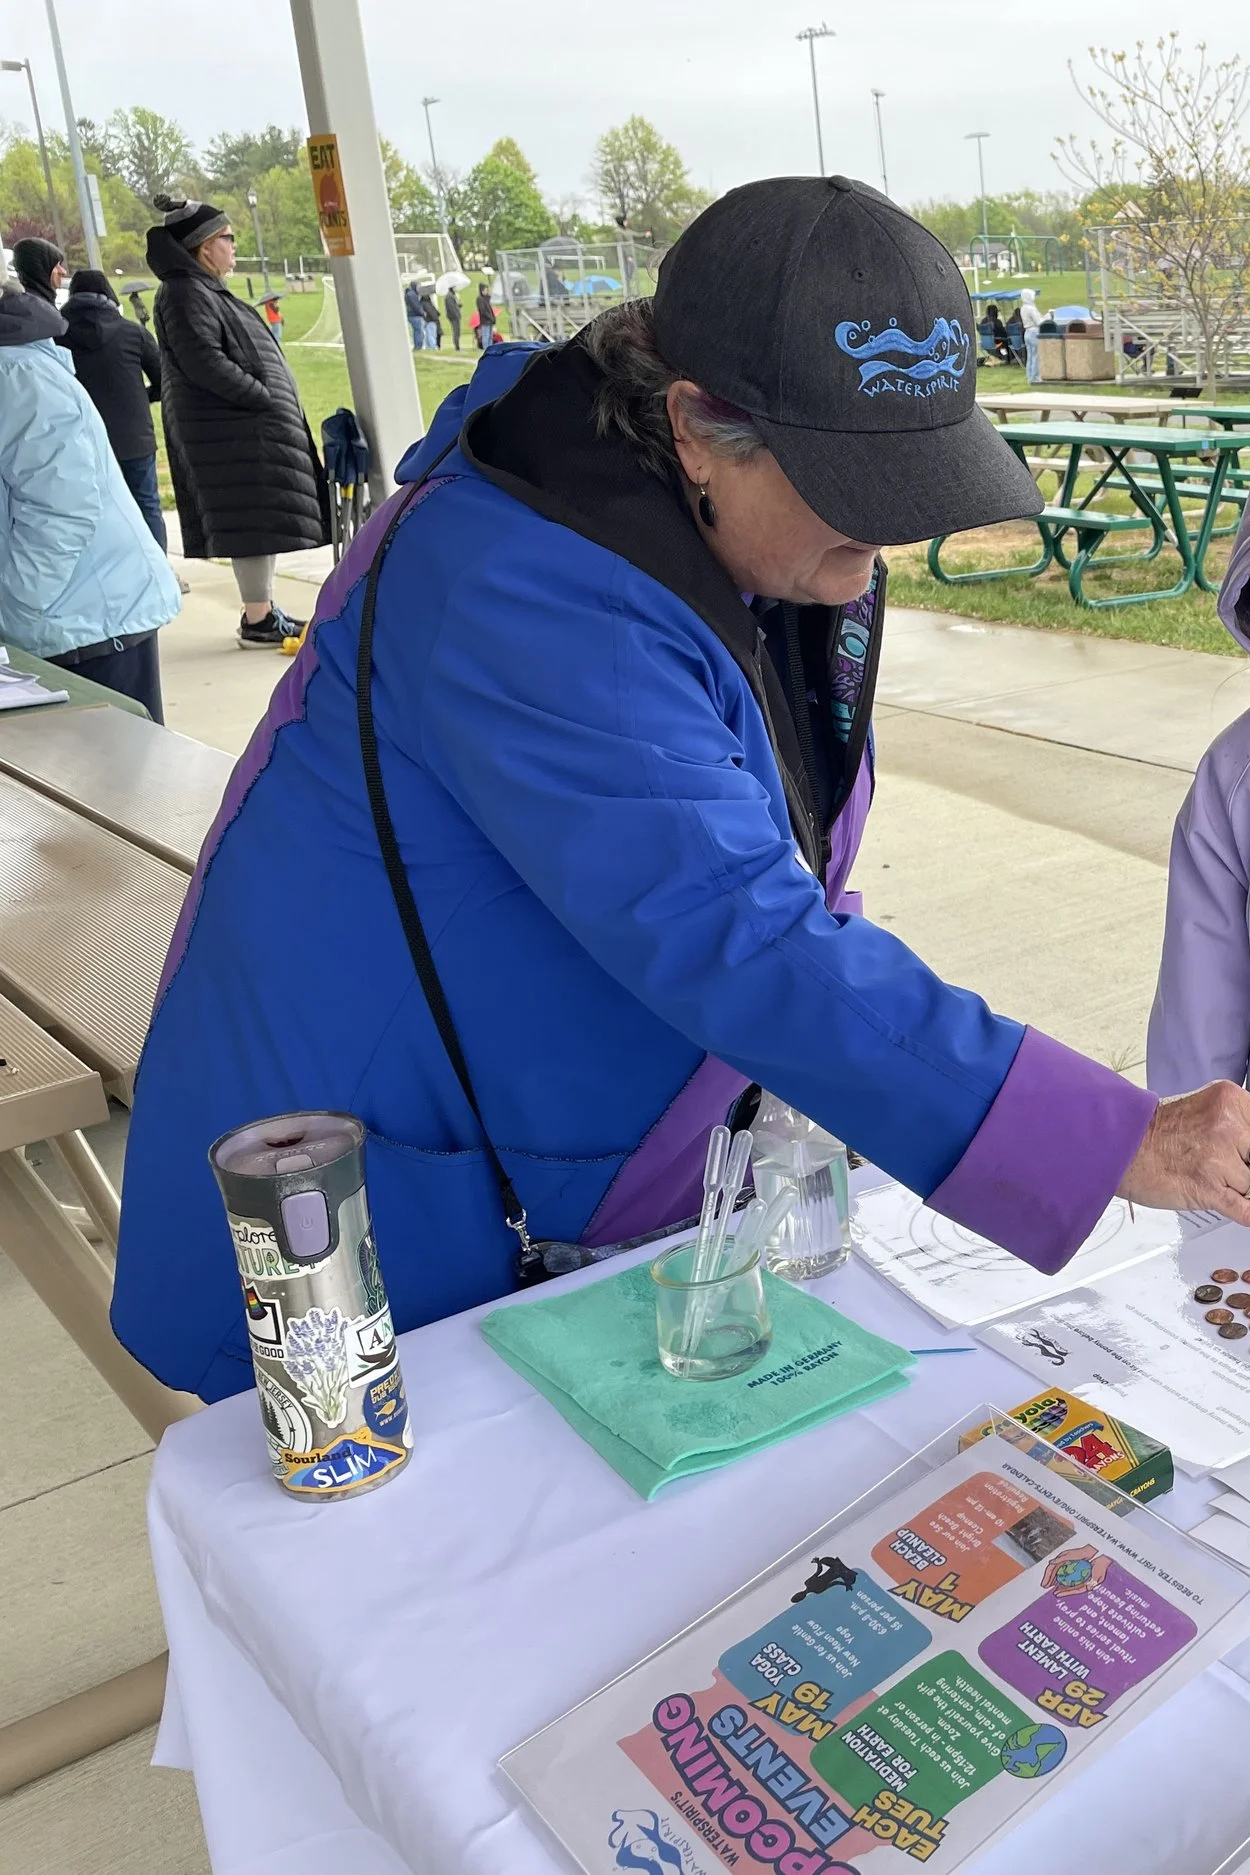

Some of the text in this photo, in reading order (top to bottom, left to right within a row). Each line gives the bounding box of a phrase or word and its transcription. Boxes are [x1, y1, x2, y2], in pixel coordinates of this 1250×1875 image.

[310, 143, 334, 170] EAT
[863, 375, 959, 398] WATERSPIRIT
[259, 1345, 284, 1358] GOOD
[1092, 1338, 1113, 1354] penny
[1110, 1351, 1122, 1361] the
[747, 1340, 843, 1388] MADE IN GERMANY
[770, 1352, 839, 1386] 100% RAYON
[270, 1384, 293, 1410] JERSEY
[1069, 1422, 1094, 1439] Teachers
[284, 1447, 353, 1465] Sourland
[312, 1447, 377, 1488] SLIM
[1090, 1451, 1126, 1471] AYONS
[964, 1495, 978, 1505] pm
[981, 1481, 1026, 1513] Registration
[997, 1478, 1029, 1502] Required
[1129, 1478, 1155, 1496] CRAYONS
[953, 1511, 985, 1534] Cleanup
[993, 1517, 1006, 1527] 10
[1000, 1461, 1140, 1559] WWW.WATERSPIRIT.ORG/EVENTS-CALENDAR
[893, 1525, 948, 1567] CLEANUP
[926, 1520, 971, 1553] Join our Sea
[934, 1511, 984, 1547] Bright Beach
[886, 1538, 930, 1571] BEACH
[1136, 1556, 1158, 1572] VISIT
[886, 1572, 978, 1626] MAY
[933, 1571, 966, 1593] 1
[1121, 1587, 1150, 1609] music.
[1154, 1567, 1195, 1597] REGISTER,
[1190, 1593, 1205, 1605] TO
[845, 1599, 866, 1616] p.m.
[854, 1589, 904, 1631] $5 per person
[1078, 1603, 1131, 1643] lament, and
[1082, 1590, 1147, 1639] cultivate hope,
[1122, 1603, 1167, 1637] featuring
[803, 1618, 862, 1667] New Moon Flow
[832, 1624, 857, 1644] Yoga
[1049, 1615, 1115, 1666] Join this online
[1052, 1598, 1137, 1665] ritual series to pray,
[760, 1640, 803, 1677] CLASS
[789, 1623, 854, 1679] Join us for Gentle
[1015, 1637, 1069, 1680] LAMENT
[1017, 1620, 1092, 1679] WITH EARTH
[746, 1652, 788, 1687] YOGA
[787, 1678, 840, 1712] 19
[893, 1699, 906, 1711] or
[935, 1677, 1006, 1741] of calm, centering
[950, 1674, 1011, 1725] mental health.
[1030, 1685, 1108, 1729] APR
[1059, 1676, 1109, 1708] 29
[746, 1686, 839, 1743] MAY
[903, 1708, 933, 1734] person
[914, 1680, 1002, 1757] Give yourself the gift
[932, 1715, 961, 1740] Zoom.
[856, 1722, 917, 1779] FOR EARTH
[876, 1704, 971, 1791] Join us each Tuesday at
[927, 1731, 941, 1743] in
[839, 1729, 909, 1792] MEDITATION
[941, 1743, 978, 1776] 12:15pm
[706, 1704, 856, 1850] EVENTS
[666, 1789, 743, 1866] WATERSPIRIT'S
[847, 1801, 942, 1862] EACH
[867, 1786, 957, 1843] TUES
